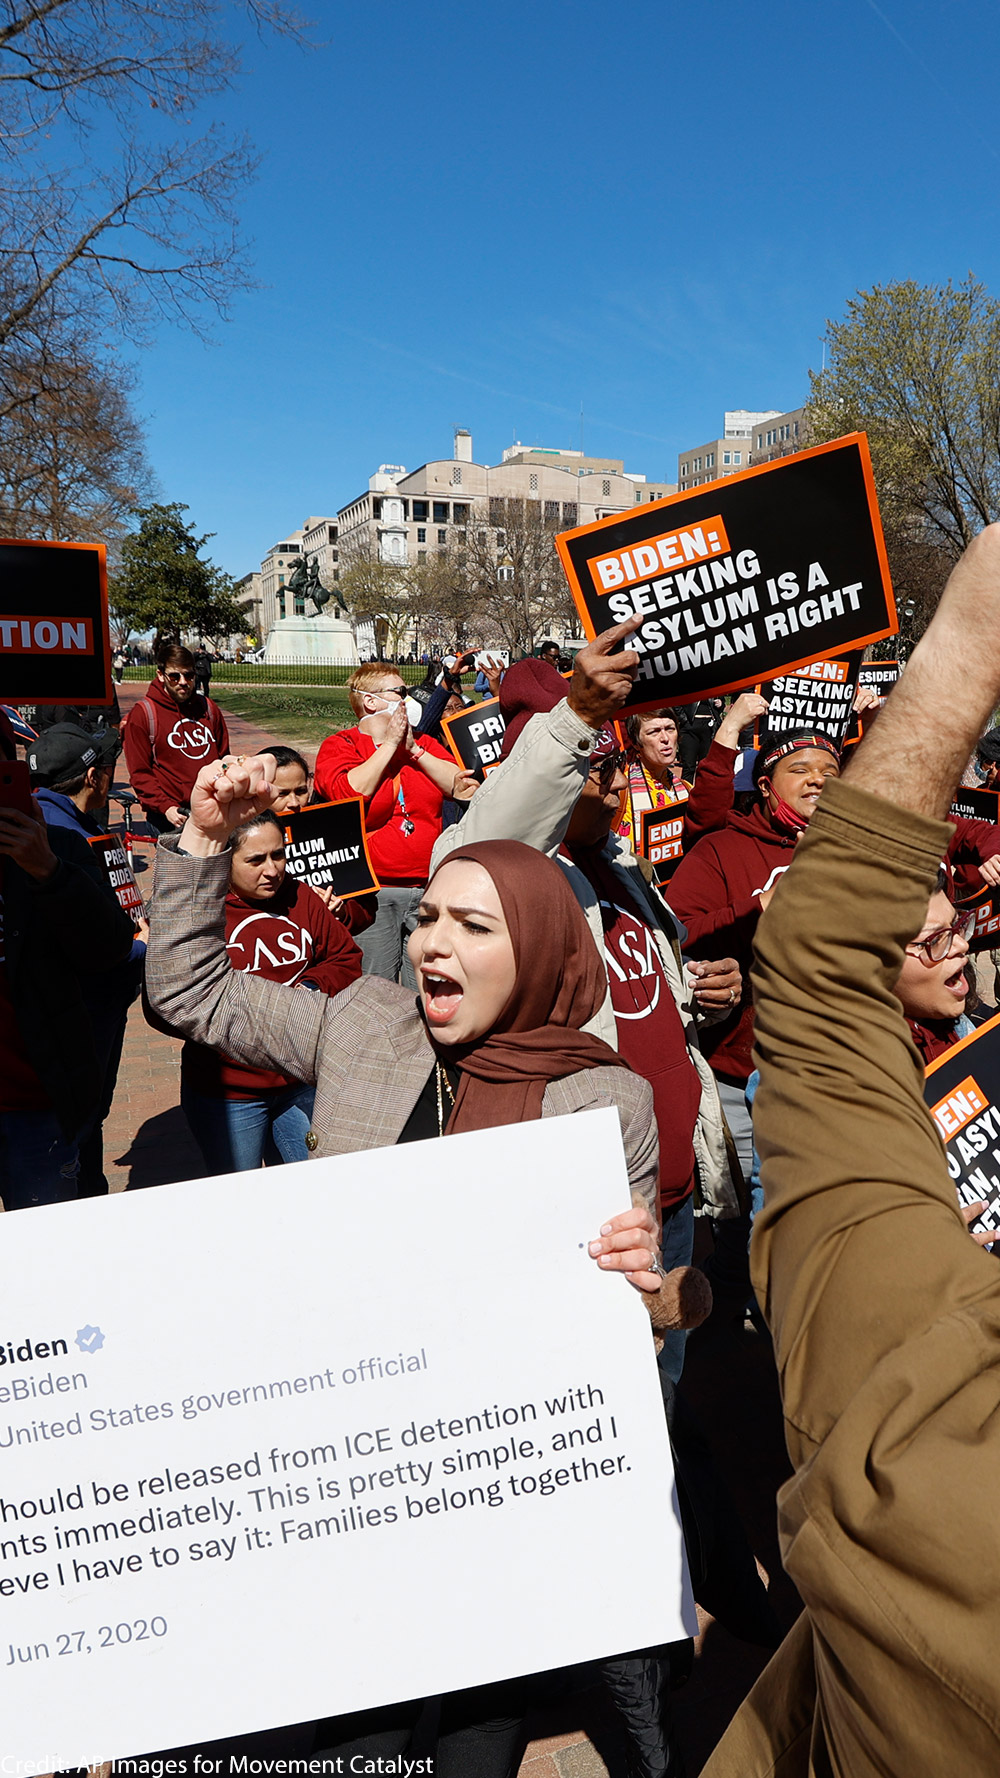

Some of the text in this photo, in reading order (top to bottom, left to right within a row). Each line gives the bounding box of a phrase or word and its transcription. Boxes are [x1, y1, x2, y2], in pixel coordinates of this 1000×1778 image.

[596, 527, 722, 589] BIDEN:
[608, 548, 761, 624] SEEKING
[0, 619, 87, 650] TION
[624, 561, 830, 655] ASYLUM IS A
[633, 581, 863, 682] HUMAN RIGHT
[768, 694, 847, 719] ASYLUM
[772, 675, 854, 700] SEEKING
[284, 844, 360, 875] NO FAMILY
[650, 820, 683, 843] END
[650, 840, 684, 863] DET
[0, 1372, 89, 1404] eBiden
[89, 1401, 174, 1431] States
[181, 1367, 336, 1420] government
[341, 1347, 428, 1386] official
[0, 1383, 605, 1523] hould be released from ICE detention with
[0, 1415, 618, 1560] nts immediately. This is pretty simple, and I
[0, 1454, 632, 1597] eve I have to say it: Families belong together.
[6, 1615, 168, 1667] Jun 27, 2020
